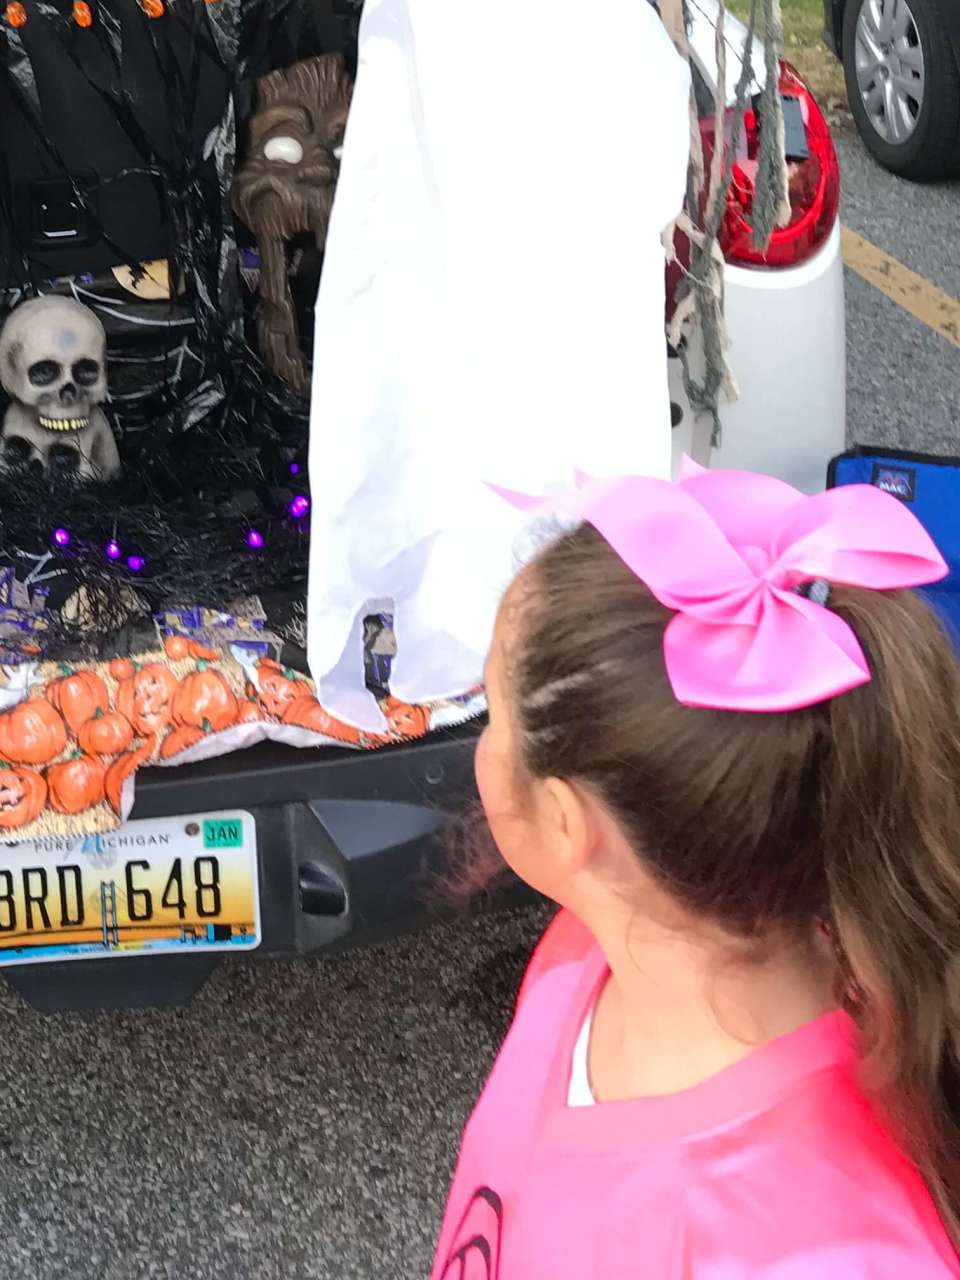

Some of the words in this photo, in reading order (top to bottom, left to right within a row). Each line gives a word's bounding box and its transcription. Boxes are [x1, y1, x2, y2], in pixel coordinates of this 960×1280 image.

[34, 839, 74, 853] PURE
[80, 833, 170, 854] MICHIGAN
[206, 825, 239, 842] JAN
[125, 856, 222, 922] 648
